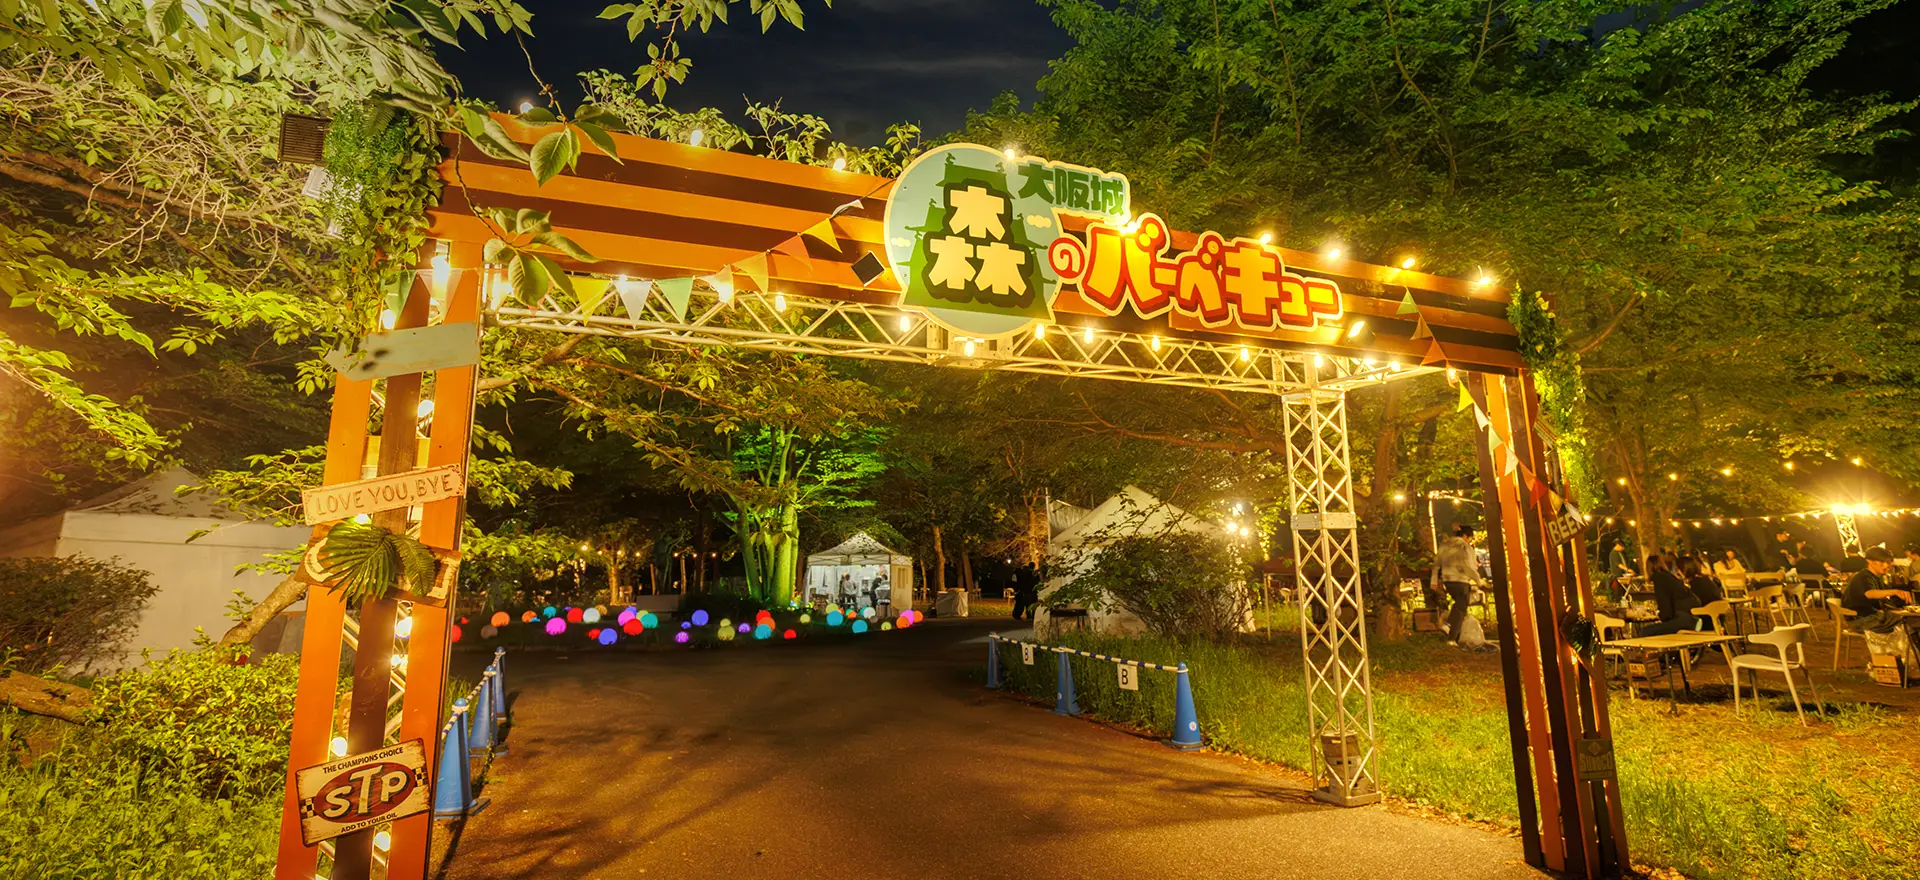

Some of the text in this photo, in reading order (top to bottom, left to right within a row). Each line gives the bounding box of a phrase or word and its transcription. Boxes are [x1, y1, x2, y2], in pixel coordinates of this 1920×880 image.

[1017, 161, 1127, 217] 大阪城
[927, 184, 1028, 296] 森
[316, 490, 365, 516] LOVE
[1121, 668, 1128, 685] B
[323, 747, 403, 775] THE CHAMPIONS CHOICE
[323, 764, 408, 818] STP
[341, 824, 357, 832] ADD
[367, 816, 386, 826] YOUR
[386, 812, 397, 820] OIL
